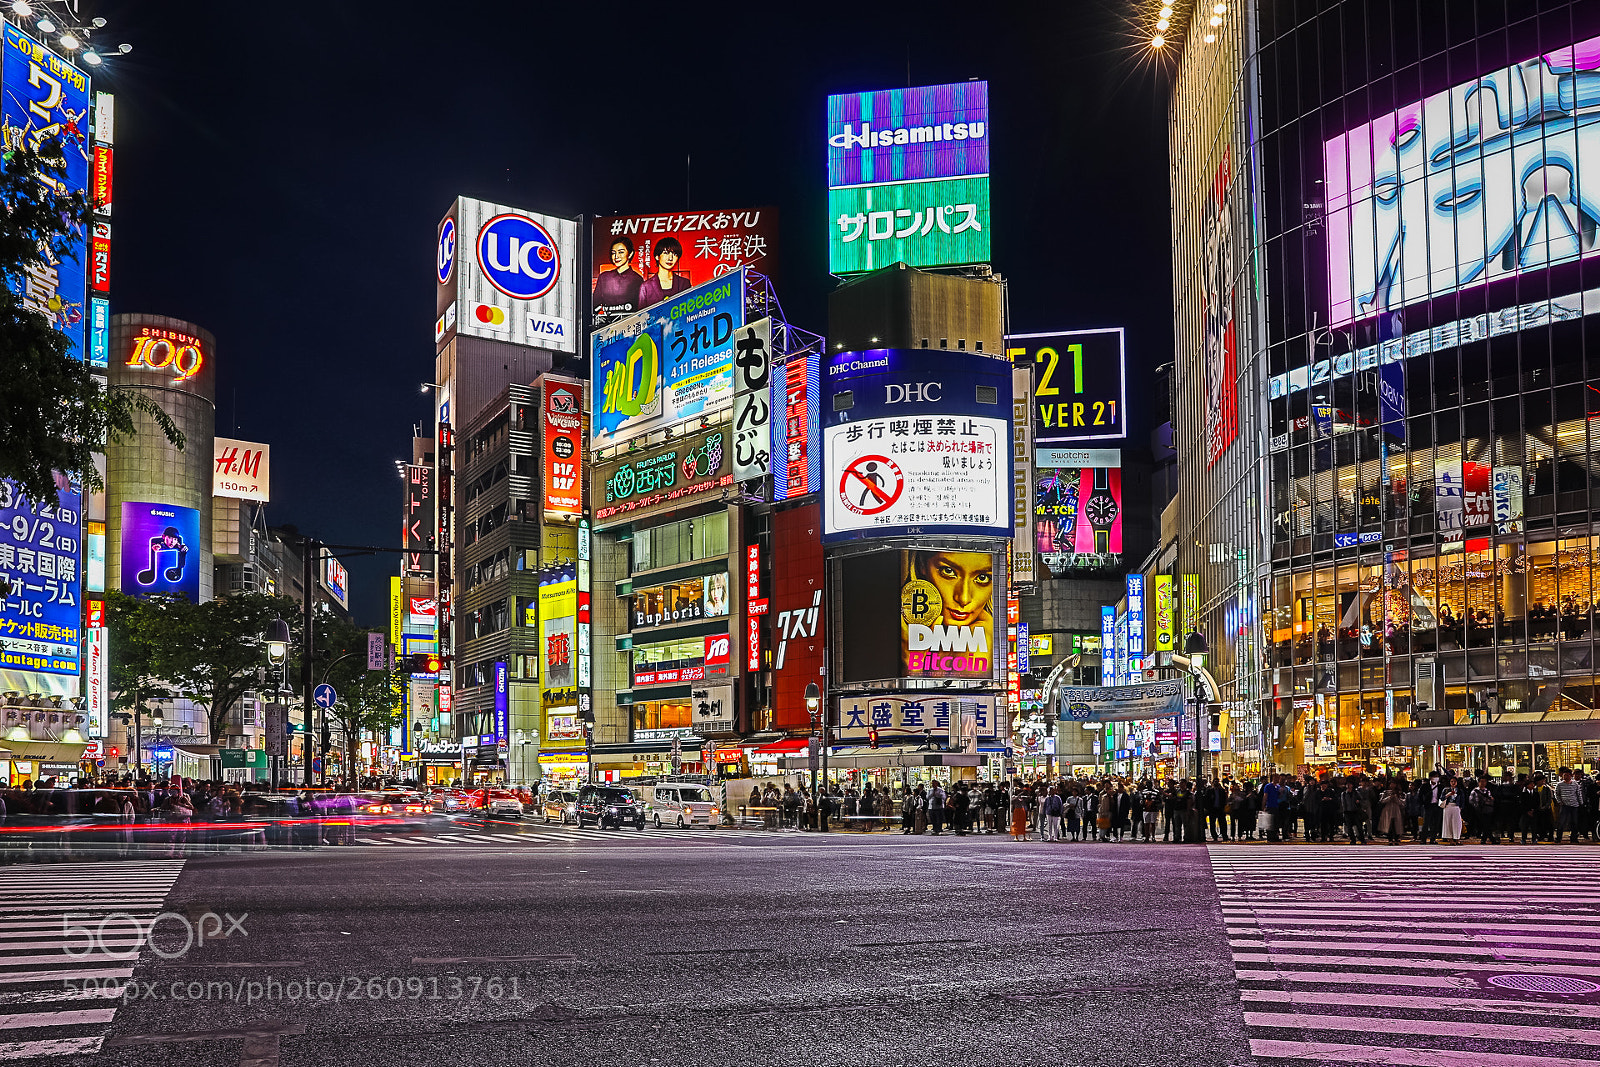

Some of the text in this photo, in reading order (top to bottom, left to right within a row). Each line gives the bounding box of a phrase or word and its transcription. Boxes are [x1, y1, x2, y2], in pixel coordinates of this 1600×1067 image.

[829, 121, 985, 149] Hisamitsu
[610, 211, 760, 236] #NTEけZKおYU
[837, 203, 982, 243] サロンパス
[694, 233, 767, 263] 未解決
[95, 252, 108, 284] ガスト
[697, 306, 716, 321] Album
[142, 327, 202, 348] SHIBUYA
[530, 318, 564, 337] VISA
[670, 312, 734, 364] うれD
[125, 336, 204, 382] 109
[671, 362, 688, 379] 4.11
[691, 348, 733, 371] Release
[829, 357, 889, 376] DHC Channel
[735, 327, 770, 472] もんじゃ
[884, 382, 942, 405] DHC
[846, 418, 979, 443] 歩行喫煙禁止
[215, 446, 263, 479] H&M
[553, 462, 574, 475] B1F
[942, 456, 993, 470] 吸いましょう
[1051, 452, 1084, 460] swatch
[219, 482, 248, 493] 150m
[421, 468, 429, 500] TOKYO
[553, 477, 575, 490] B2F
[636, 461, 675, 494] 西村
[1014, 469, 1028, 528] neon
[0, 543, 77, 582] 東京国際
[636, 604, 701, 627] Euphoria
[1128, 578, 1143, 653] 洋服の青山
[547, 632, 570, 667] 薬
[706, 638, 729, 660] JTB
[908, 623, 988, 653] DMM
[1158, 634, 1170, 643] 4F
[908, 652, 988, 672] Bitcoin
[498, 667, 506, 693] MIZUHO
[419, 739, 462, 754] グルメタウン
